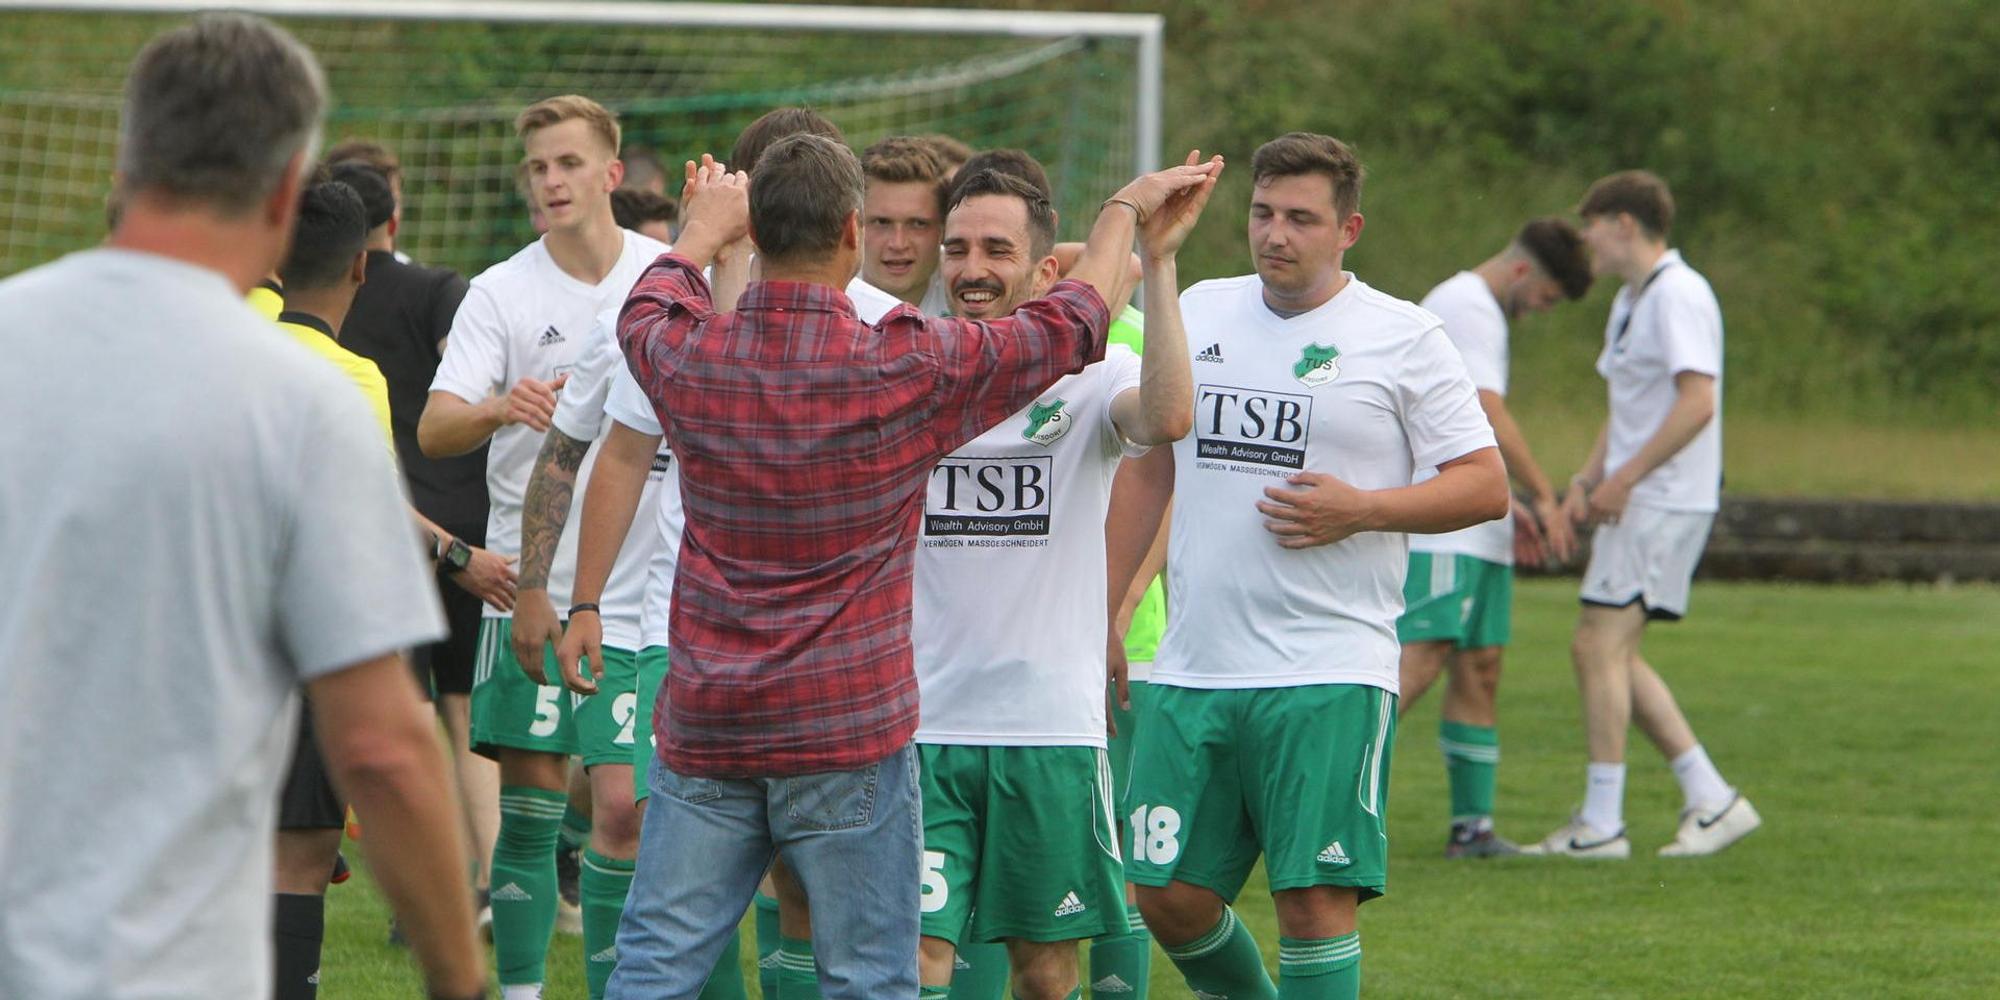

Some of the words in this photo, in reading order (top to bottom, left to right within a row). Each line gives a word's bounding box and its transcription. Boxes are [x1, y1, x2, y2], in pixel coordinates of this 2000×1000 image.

[1195, 353, 1224, 364] adidas
[1303, 357, 1333, 370] TUS
[1202, 391, 1302, 443] TSB
[1201, 443, 1228, 456] Wealth
[1231, 446, 1268, 461] Advisory
[1271, 451, 1299, 464] GmbH
[933, 464, 1045, 512] TSB
[930, 520, 963, 531] Wealth
[967, 521, 1010, 533] Advisory
[1013, 520, 1044, 531] GmbH
[924, 538, 964, 548] VERMÖGEN
[529, 684, 561, 737] 5
[1129, 803, 1182, 865] 18
[1317, 853, 1351, 865] adidas
[1054, 903, 1086, 917] adidas
